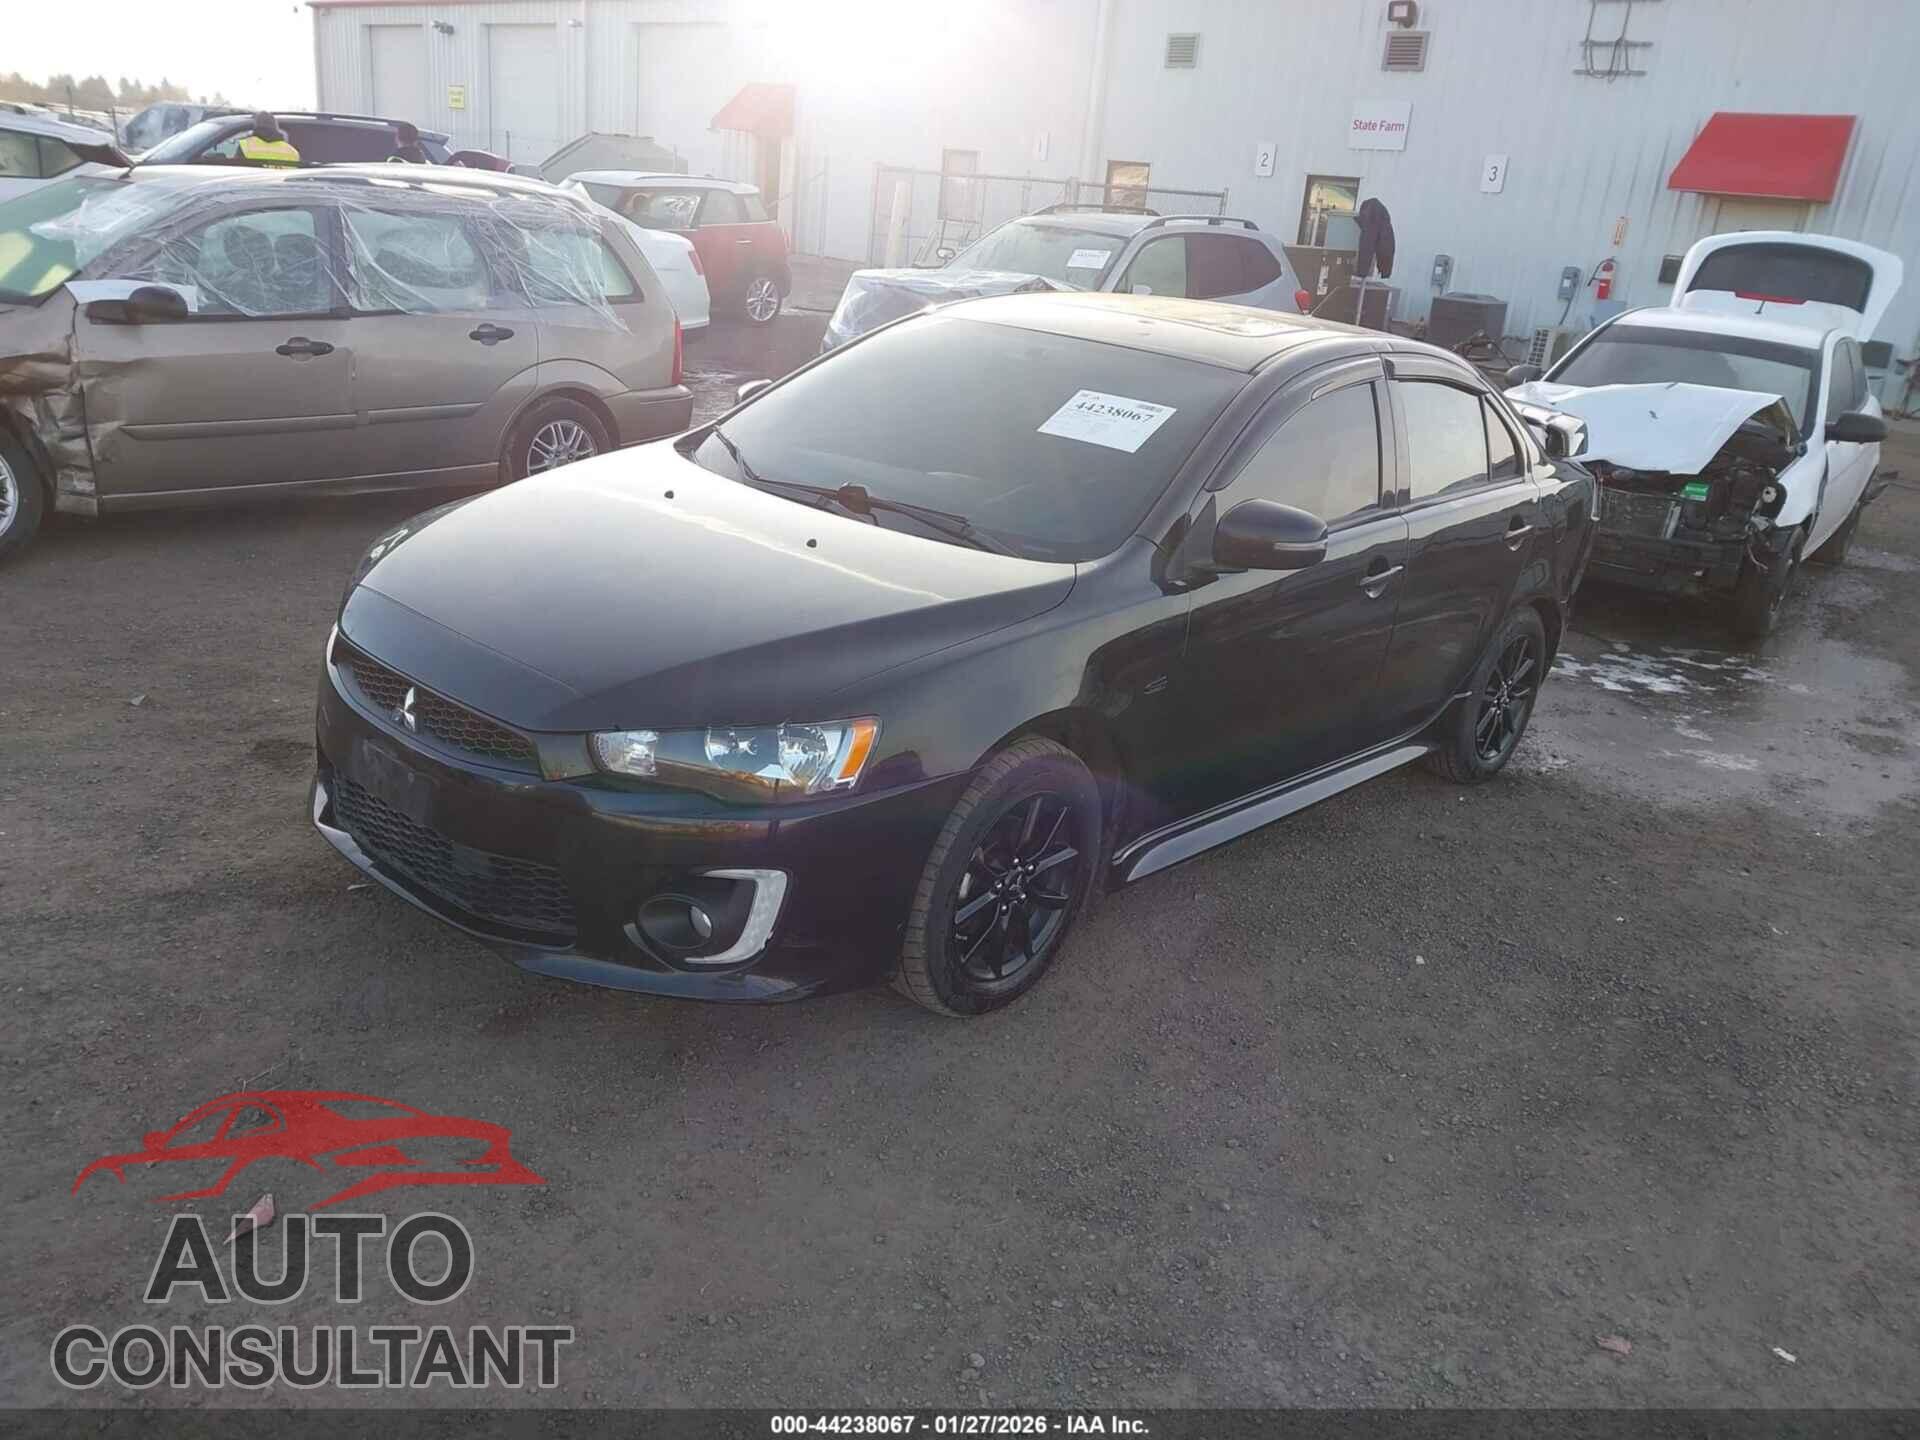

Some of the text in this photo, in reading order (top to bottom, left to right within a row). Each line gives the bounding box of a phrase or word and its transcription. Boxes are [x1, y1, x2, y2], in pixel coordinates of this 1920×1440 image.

[1352, 119, 1405, 133] State Farm
[1260, 152, 1269, 168] 2
[1488, 165, 1499, 182] 3
[1075, 401, 1154, 423] 44238067
